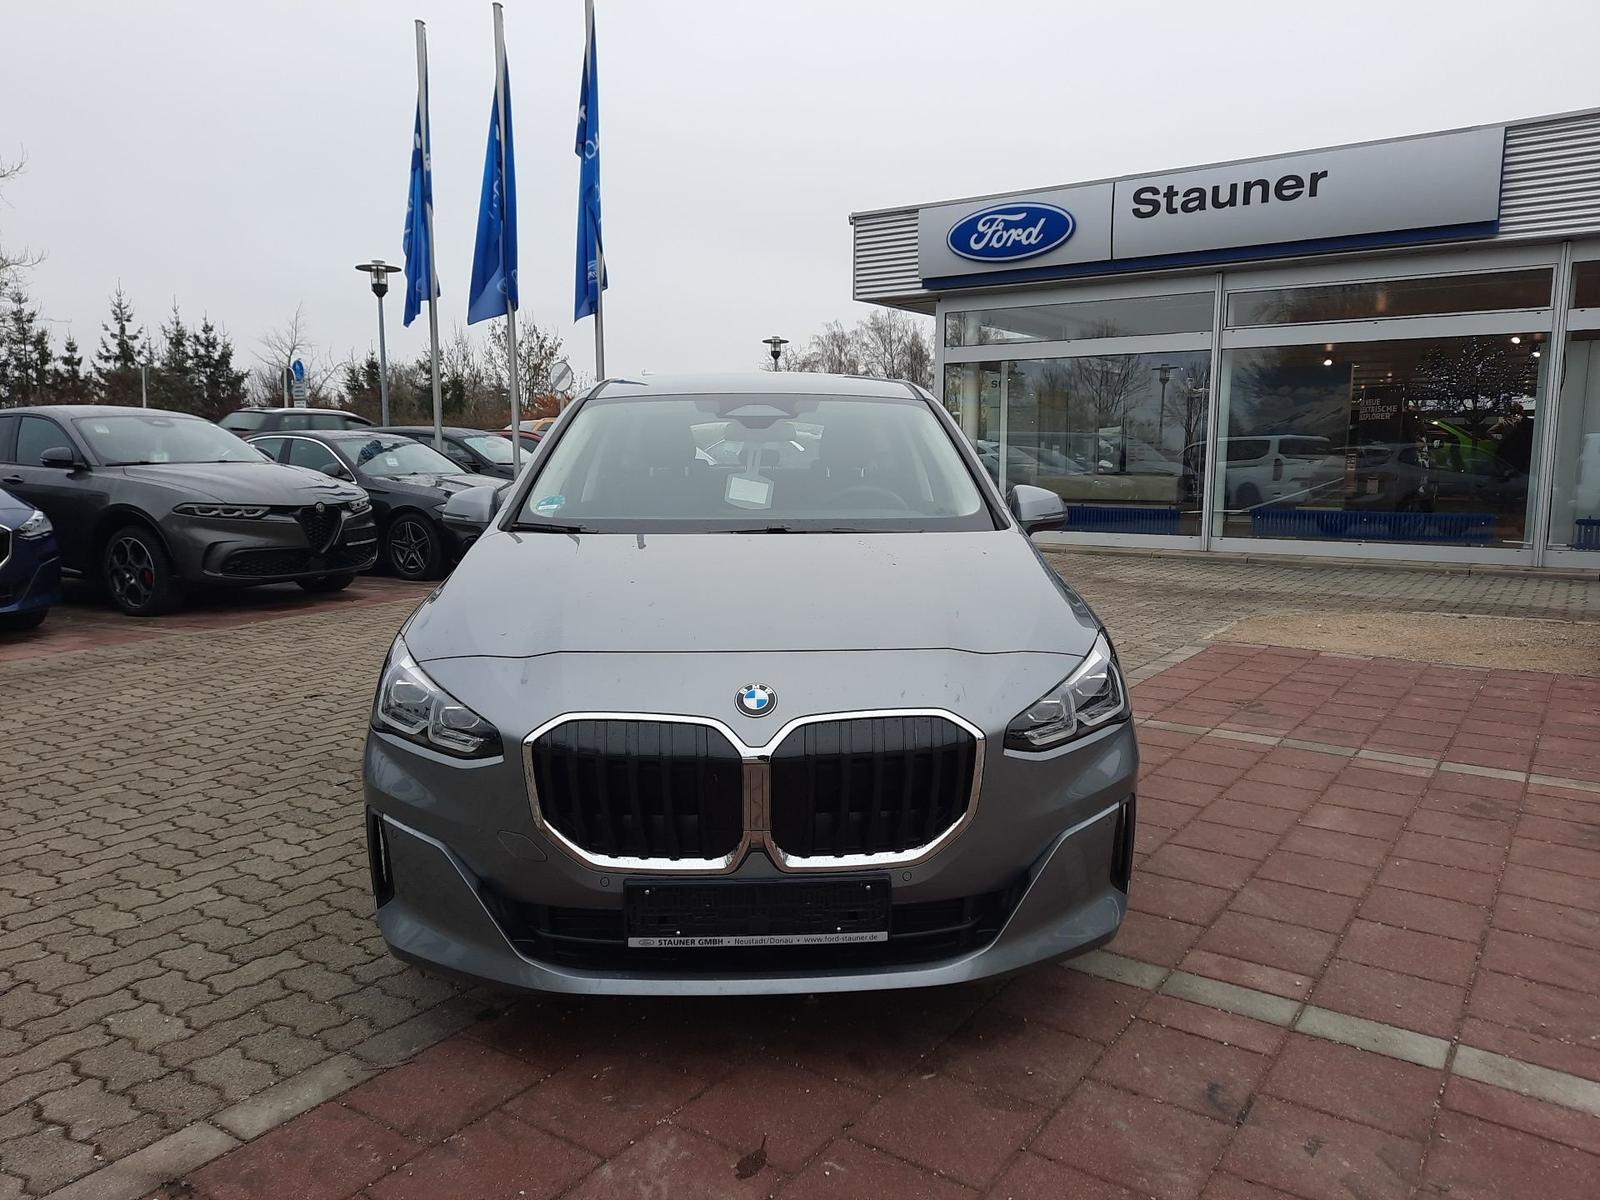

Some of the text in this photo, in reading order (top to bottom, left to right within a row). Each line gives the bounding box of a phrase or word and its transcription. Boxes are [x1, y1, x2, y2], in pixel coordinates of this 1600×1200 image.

[1131, 170, 1328, 219] Stauner
[970, 212, 1043, 251] Ford
[658, 938, 696, 946] STAUNER
[698, 938, 724, 946] GMBH
[734, 937, 794, 946] Neustadt/Donau
[804, 933, 878, 943] www.ford-stauner.de
